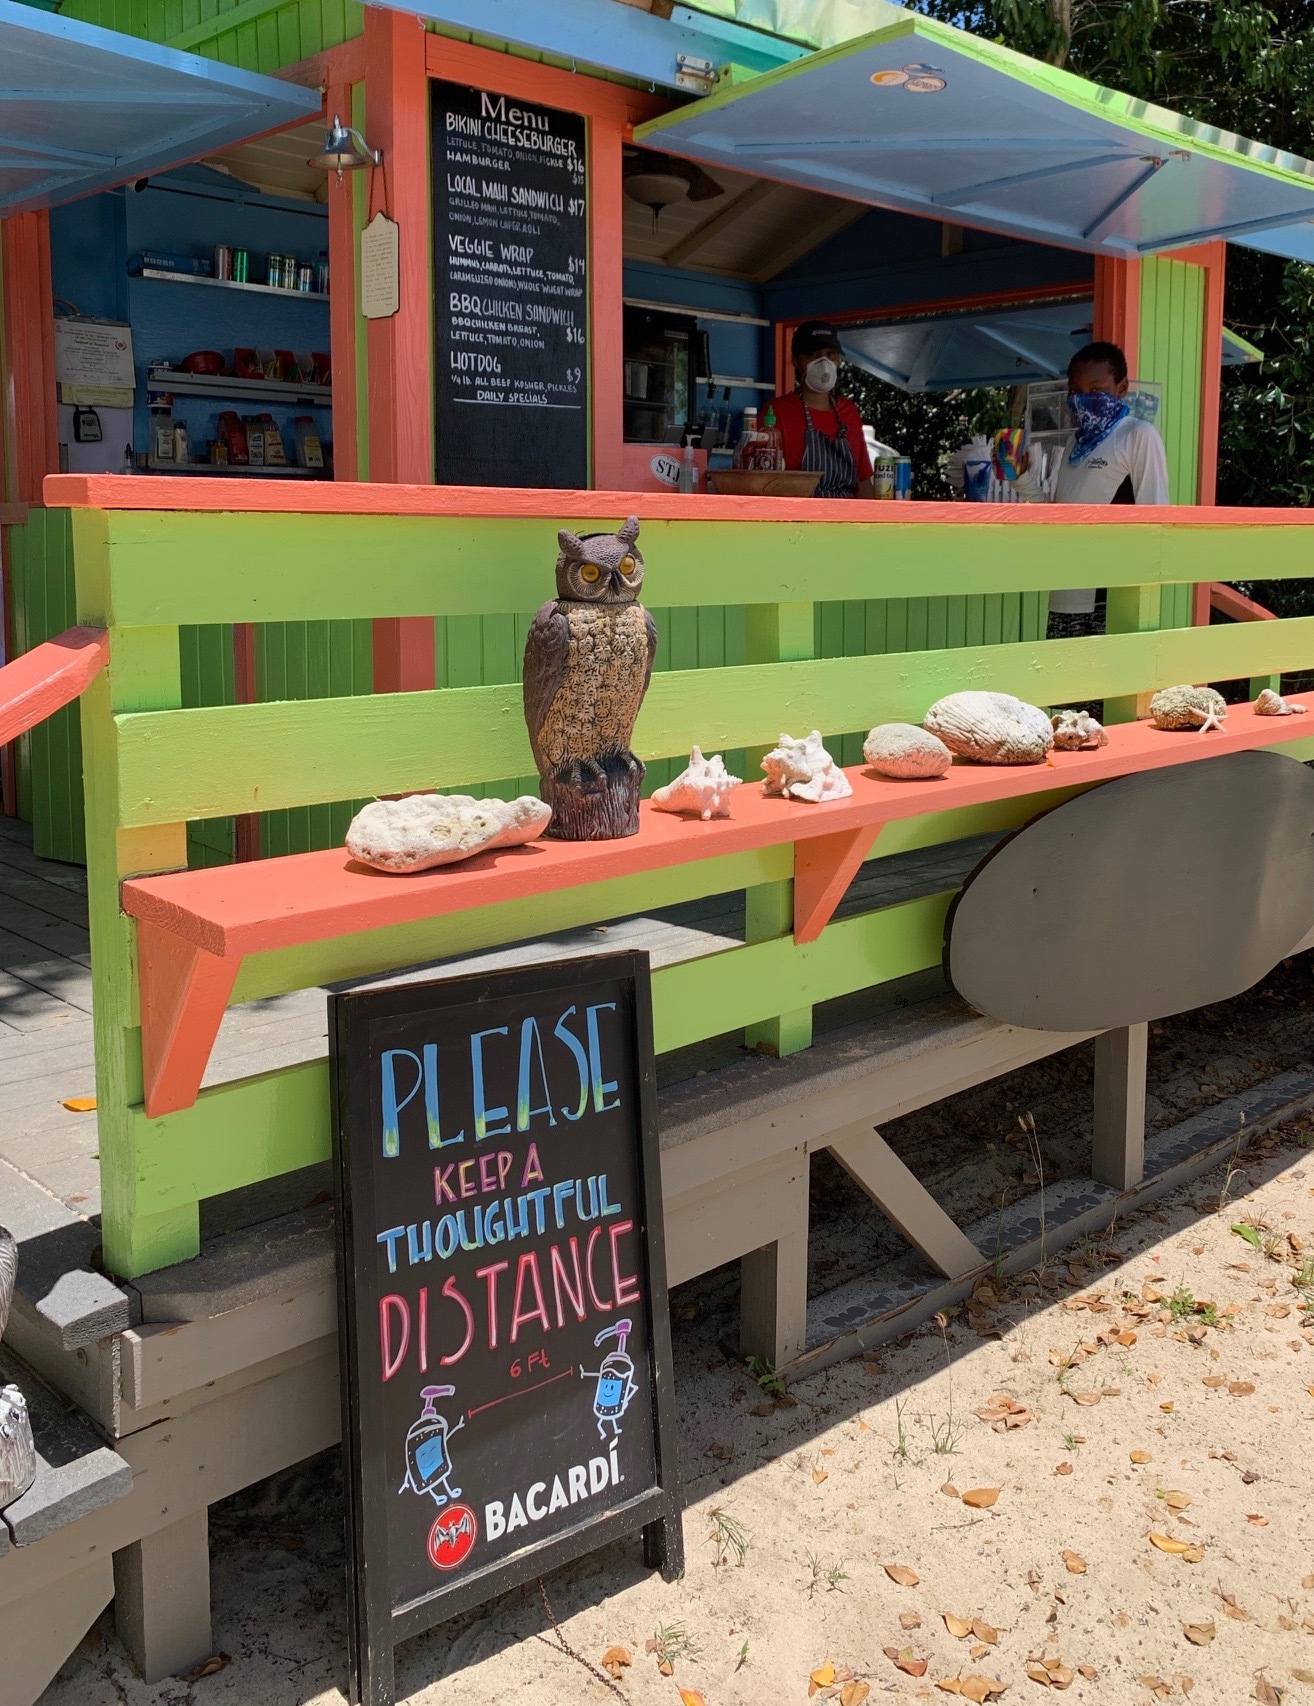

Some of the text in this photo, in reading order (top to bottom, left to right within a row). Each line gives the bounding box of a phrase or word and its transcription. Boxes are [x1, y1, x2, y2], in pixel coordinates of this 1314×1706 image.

[481, 91, 549, 131] Menu
[446, 112, 577, 158] BIKINI CHEESEBURGER
[446, 149, 584, 185] HAMBURGER $15
[566, 156, 585, 173] $16
[447, 172, 585, 217] LOCAL MAHI SANDWICH $17
[448, 197, 480, 210] GRILLED
[448, 233, 585, 275] VEGGIE WRAP $14
[525, 303, 574, 327] SANDWICH
[566, 326, 585, 344] $16
[450, 350, 582, 384] HOTDOG $9
[474, 376, 489, 387] ALL
[490, 377, 511, 388] BEEF
[477, 390, 505, 402] DAILY
[381, 1002, 621, 1158] PLEASE
[434, 1142, 544, 1205] KEEP A
[377, 1174, 622, 1274] THOUGHTFUL
[379, 1219, 641, 1382] DISTANCE
[508, 1349, 551, 1378] 6 Ft
[485, 1436, 620, 1542] BACARDÍ
